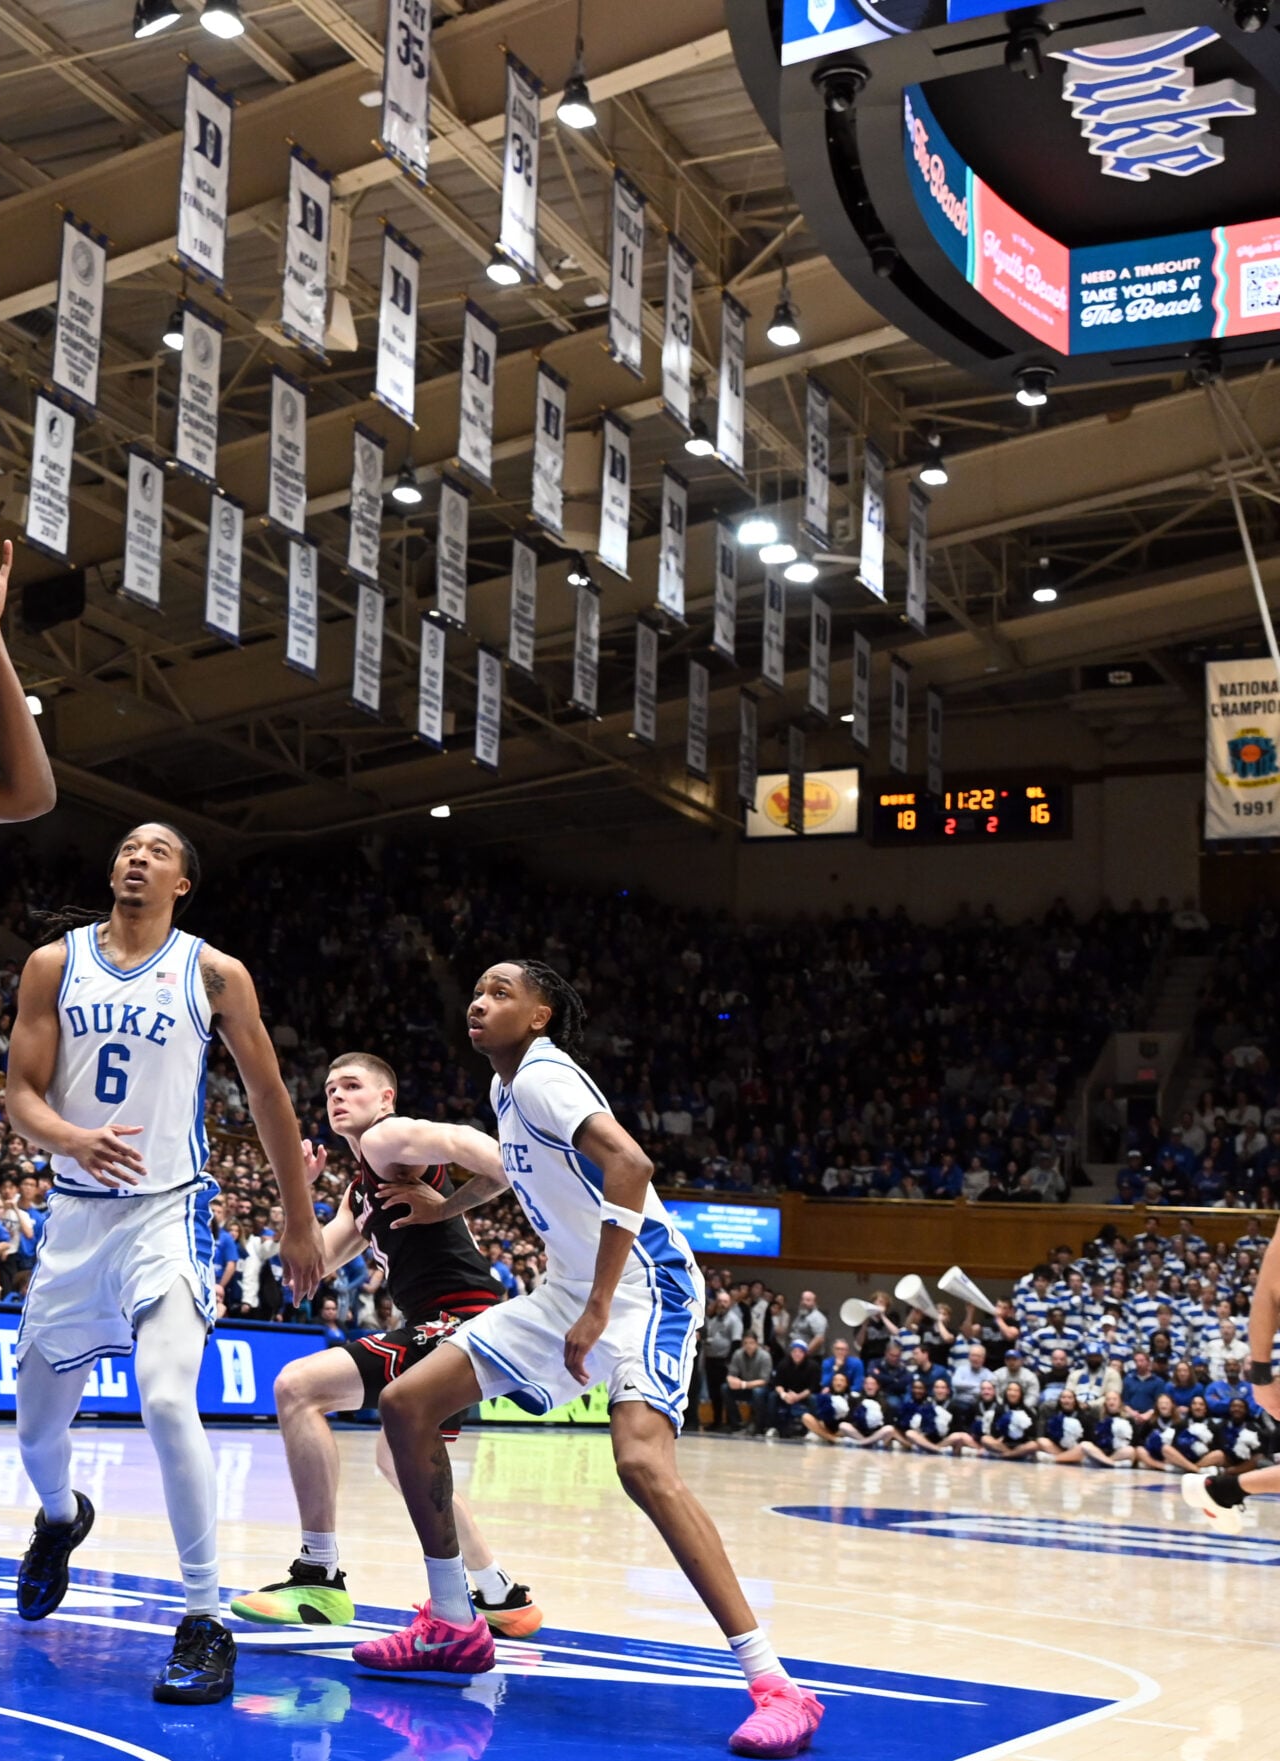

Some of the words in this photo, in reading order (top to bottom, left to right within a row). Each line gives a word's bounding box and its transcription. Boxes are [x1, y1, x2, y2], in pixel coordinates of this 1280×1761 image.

[397, 20, 425, 79] 35
[1081, 268, 1116, 284] NEED
[1119, 267, 1131, 280] A
[1134, 257, 1201, 278] TIMEOUT?
[1023, 263, 1068, 311] Beach
[1080, 286, 1118, 304] TAKE
[1121, 279, 1177, 299] YOURS
[1181, 275, 1202, 291] AT
[1080, 302, 1124, 328] The
[1125, 292, 1202, 323] Beach
[880, 793, 915, 806] DUKE
[945, 789, 995, 810] 11:22
[1030, 803, 1050, 824] 16
[1233, 801, 1274, 816] 1991
[897, 810, 916, 830] 18
[944, 818, 957, 835] 2
[986, 816, 999, 833] 2
[65, 1003, 176, 1047] DUKE
[95, 1043, 131, 1105] 6
[502, 1143, 533, 1173] KE
[513, 1180, 550, 1232] 3
